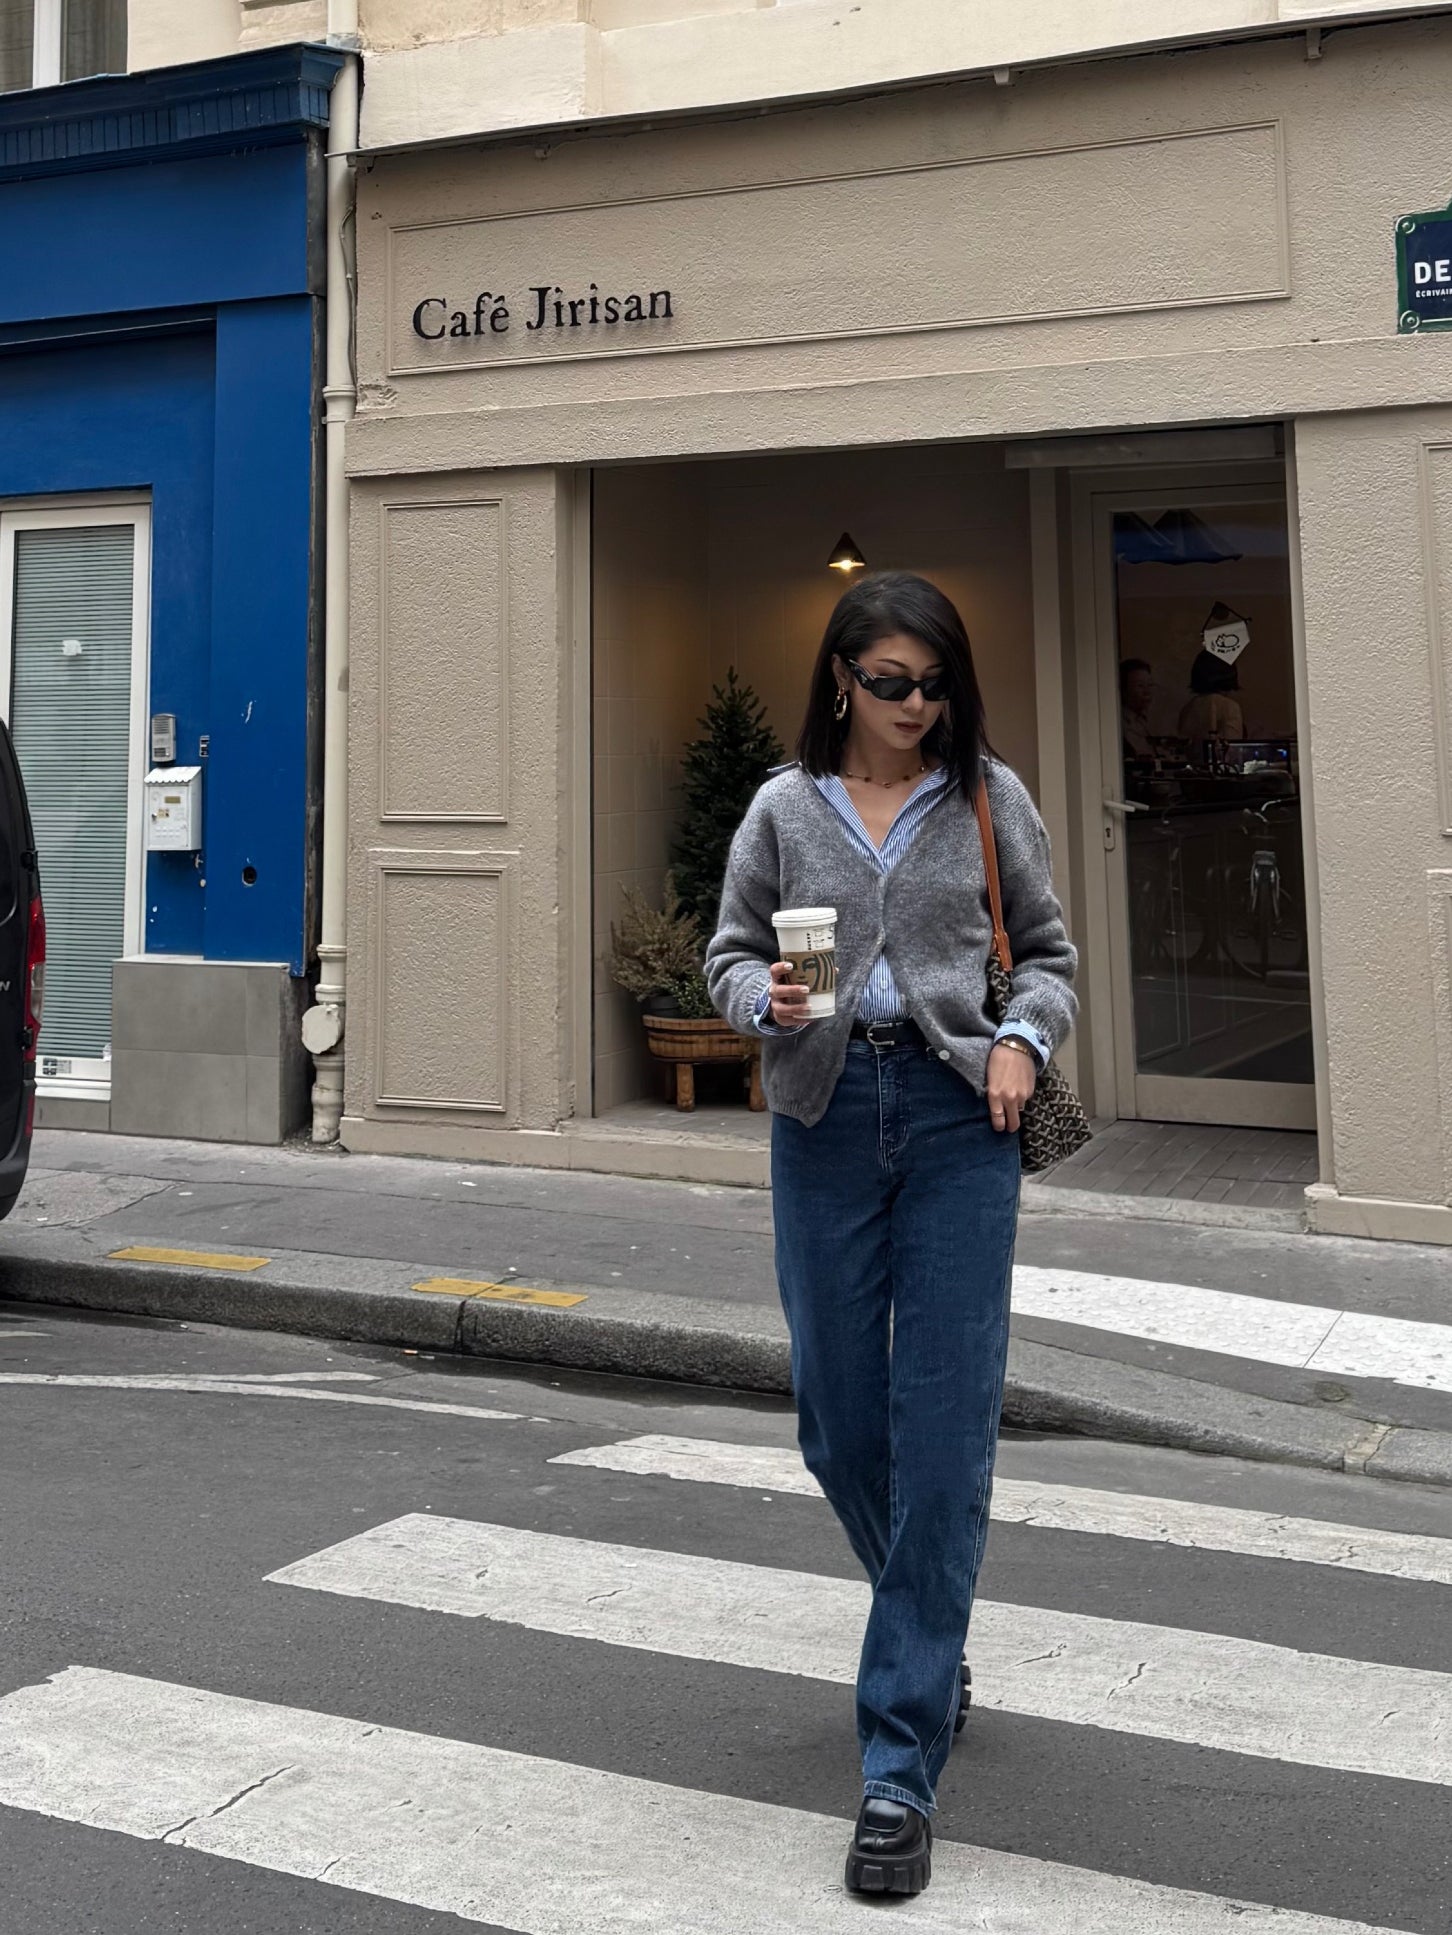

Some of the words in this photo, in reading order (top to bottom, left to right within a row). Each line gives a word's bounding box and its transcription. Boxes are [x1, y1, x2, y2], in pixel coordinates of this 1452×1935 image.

[1414, 259, 1452, 284] DE
[412, 291, 510, 340] Café
[526, 283, 674, 330] Jirisan
